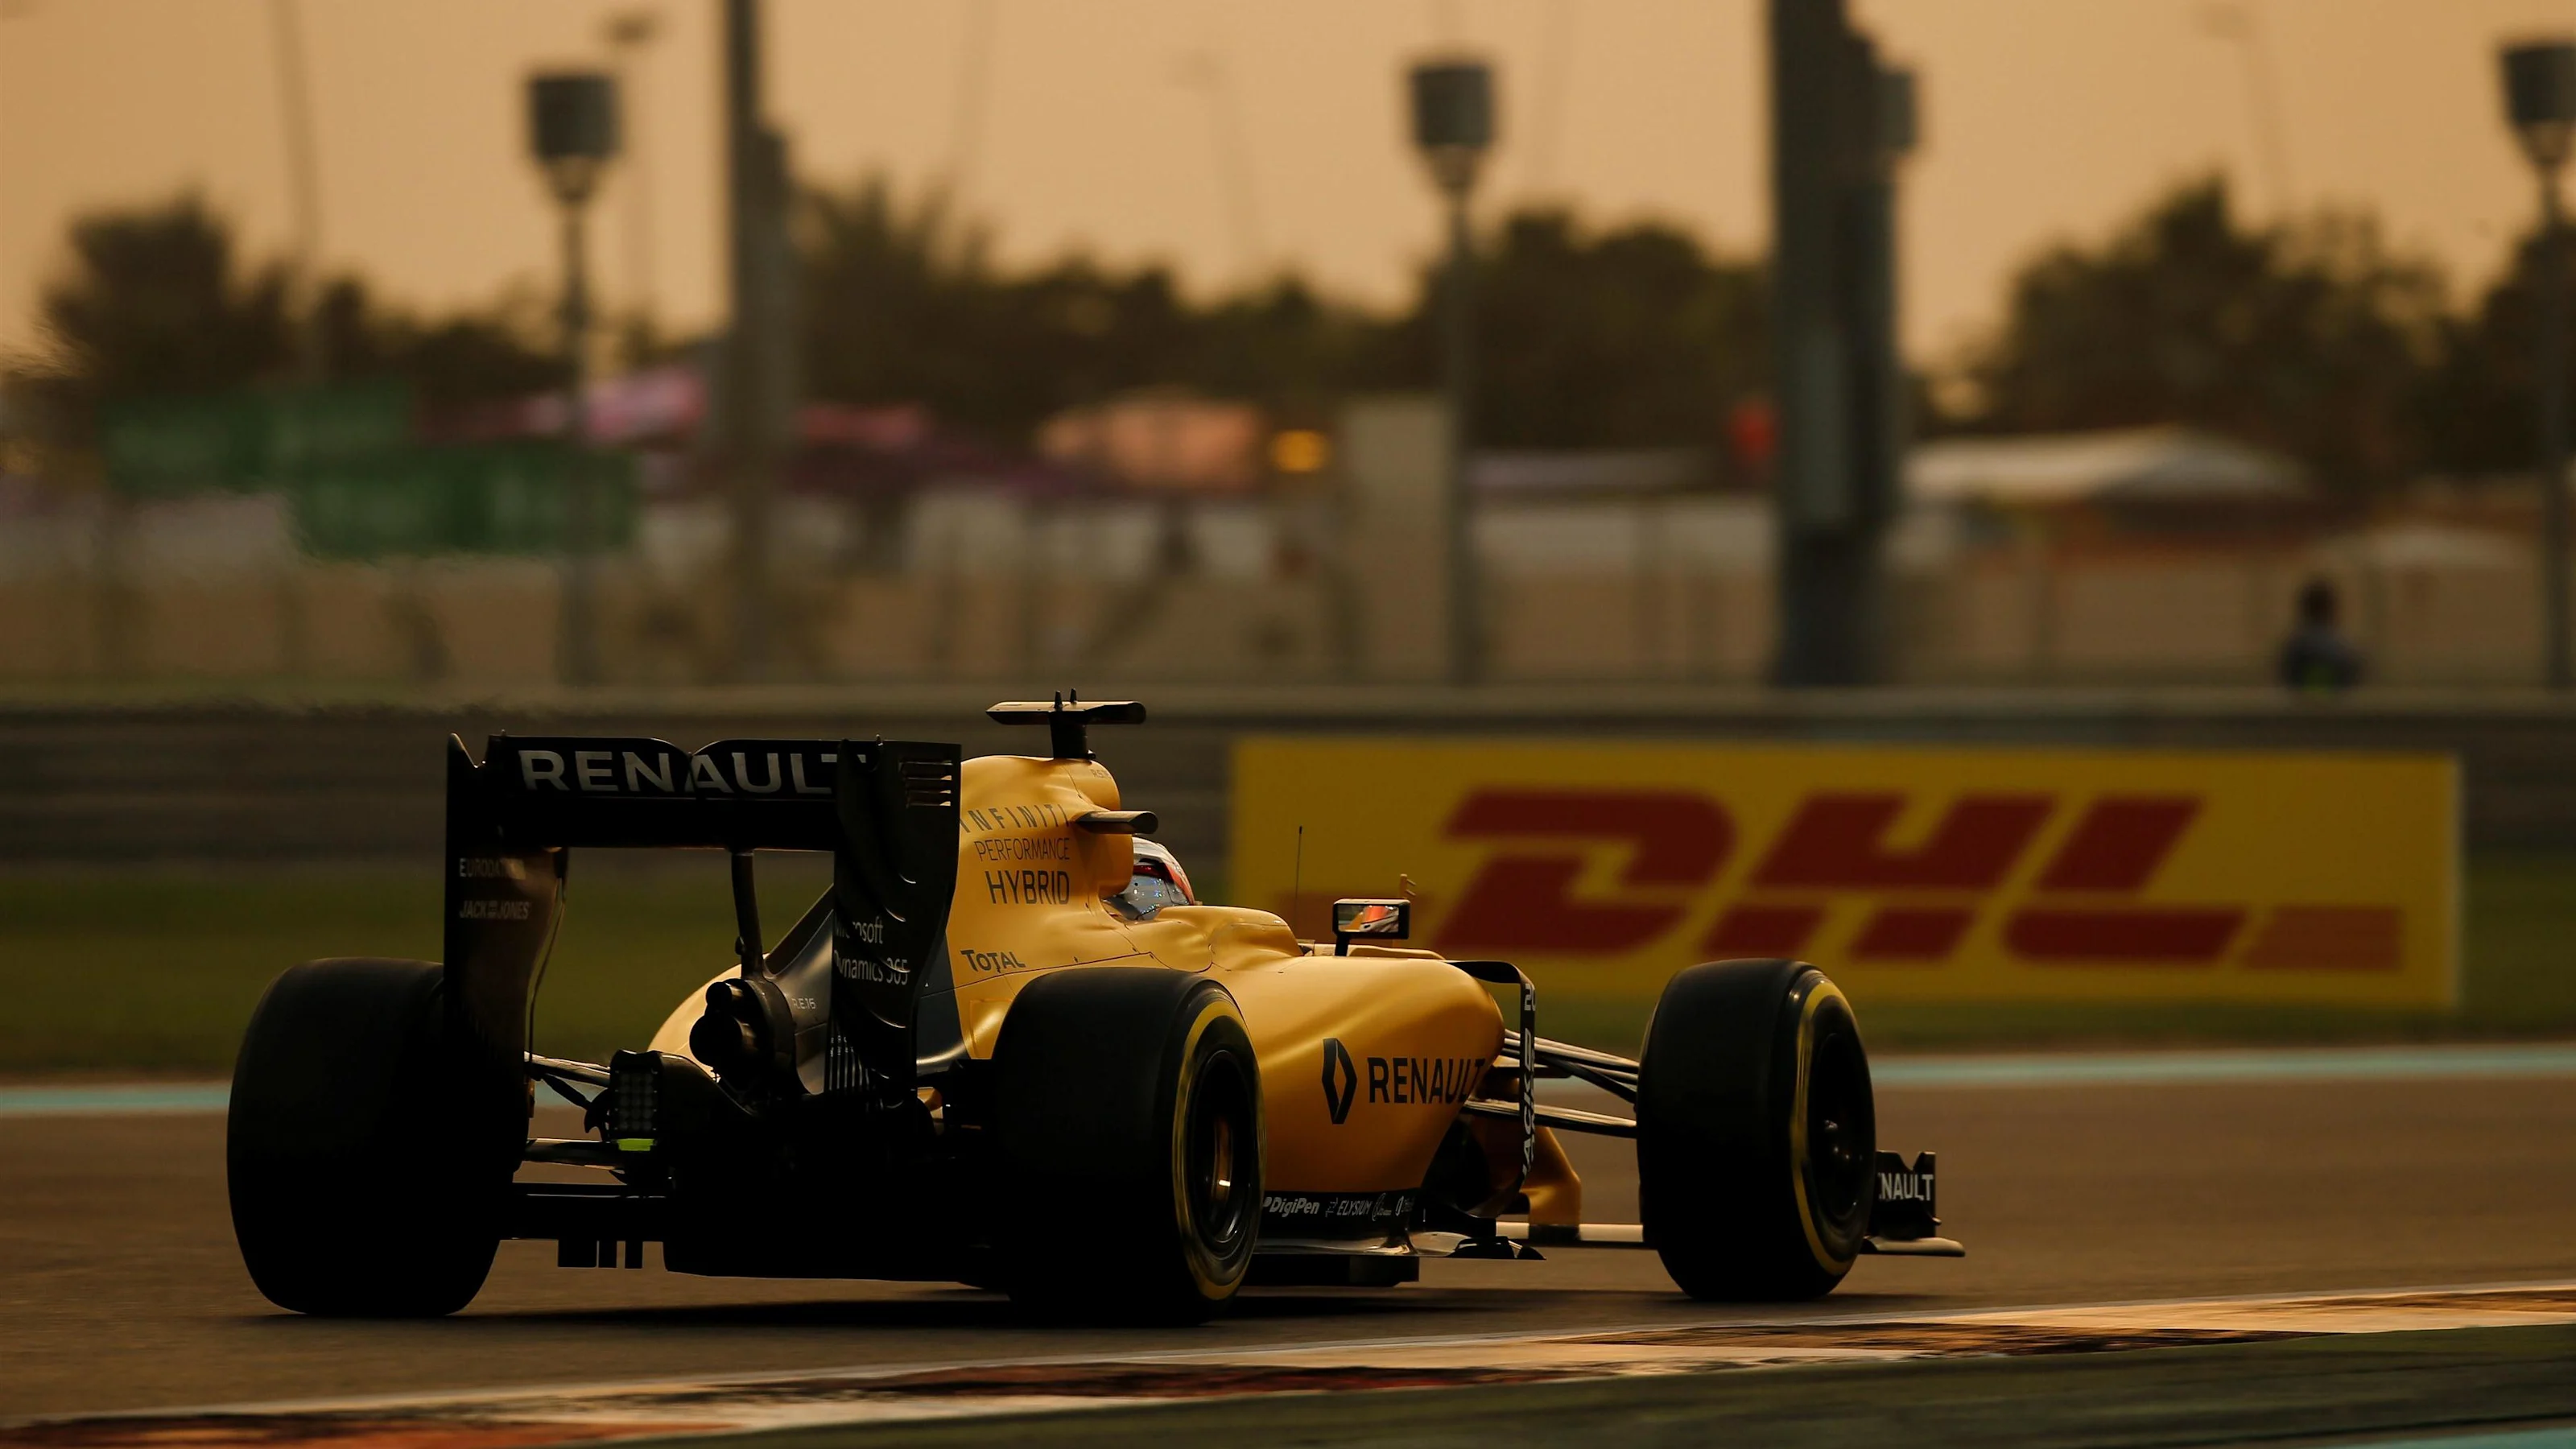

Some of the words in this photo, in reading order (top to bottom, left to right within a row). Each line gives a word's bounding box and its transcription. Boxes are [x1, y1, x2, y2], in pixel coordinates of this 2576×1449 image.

[958, 804, 1069, 833] INFINITI
[973, 837, 1071, 861] PERFORMANCE
[985, 869, 1071, 905] HYBRID
[1433, 788, 2244, 962] DHL
[496, 899, 530, 920] JONES
[886, 956, 909, 986] 365
[960, 949, 1026, 973] TOTAL
[1367, 1056, 1486, 1104] RENAULT
[1876, 1171, 1934, 1202] NAULT
[1268, 1196, 1321, 1219] DigiPen
